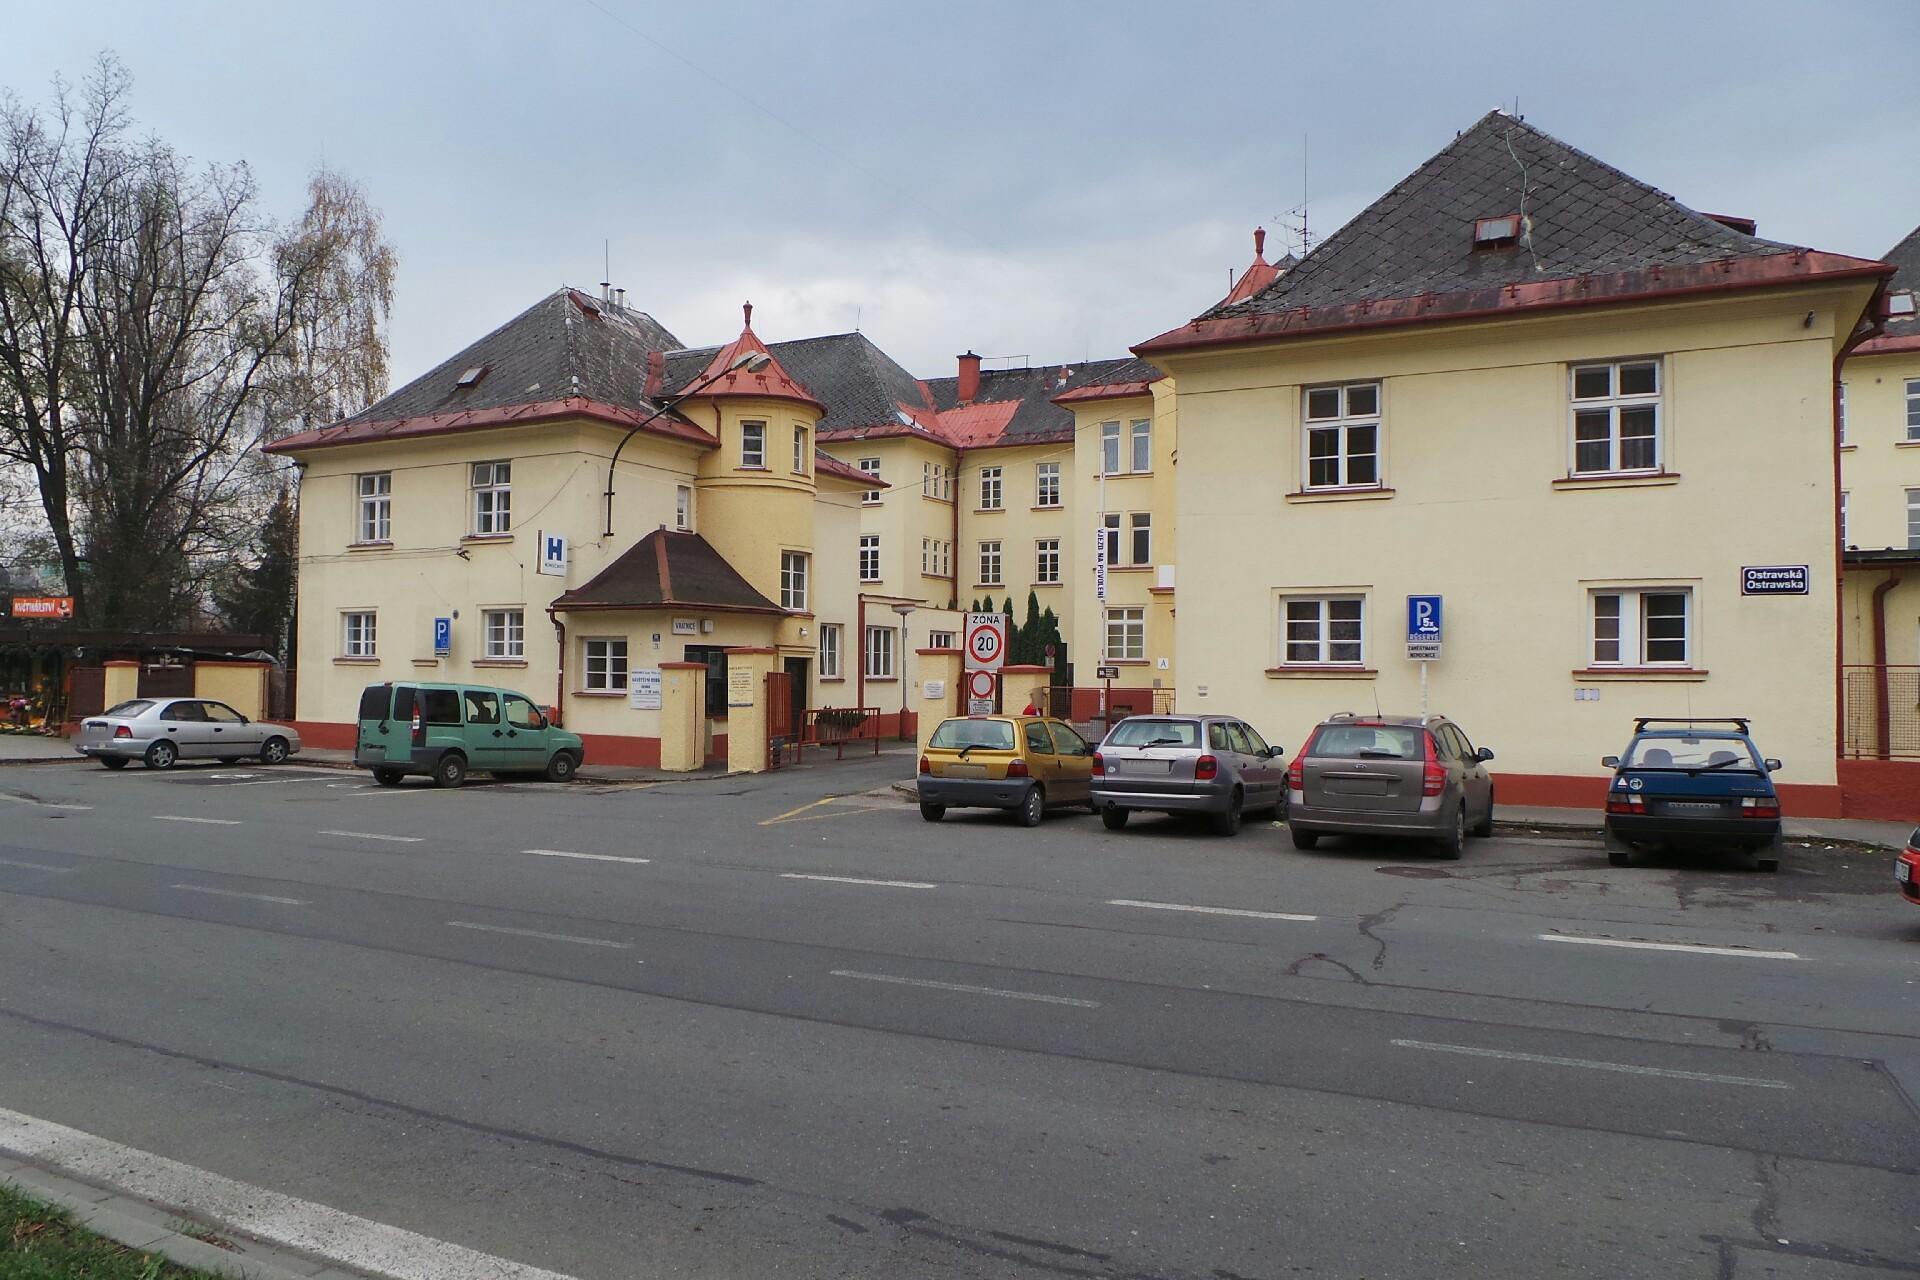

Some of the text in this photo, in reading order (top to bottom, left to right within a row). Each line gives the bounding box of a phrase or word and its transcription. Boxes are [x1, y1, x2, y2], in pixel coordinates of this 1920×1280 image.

[547, 537, 563, 561] H
[1097, 552, 1104, 563] NA
[1747, 570, 1803, 579] Ostravská
[1747, 580, 1803, 589] Ostrawska
[1416, 601, 1432, 626] P
[1422, 617, 1434, 626] 5x
[437, 622, 446, 640] P
[977, 636, 994, 651] 20
